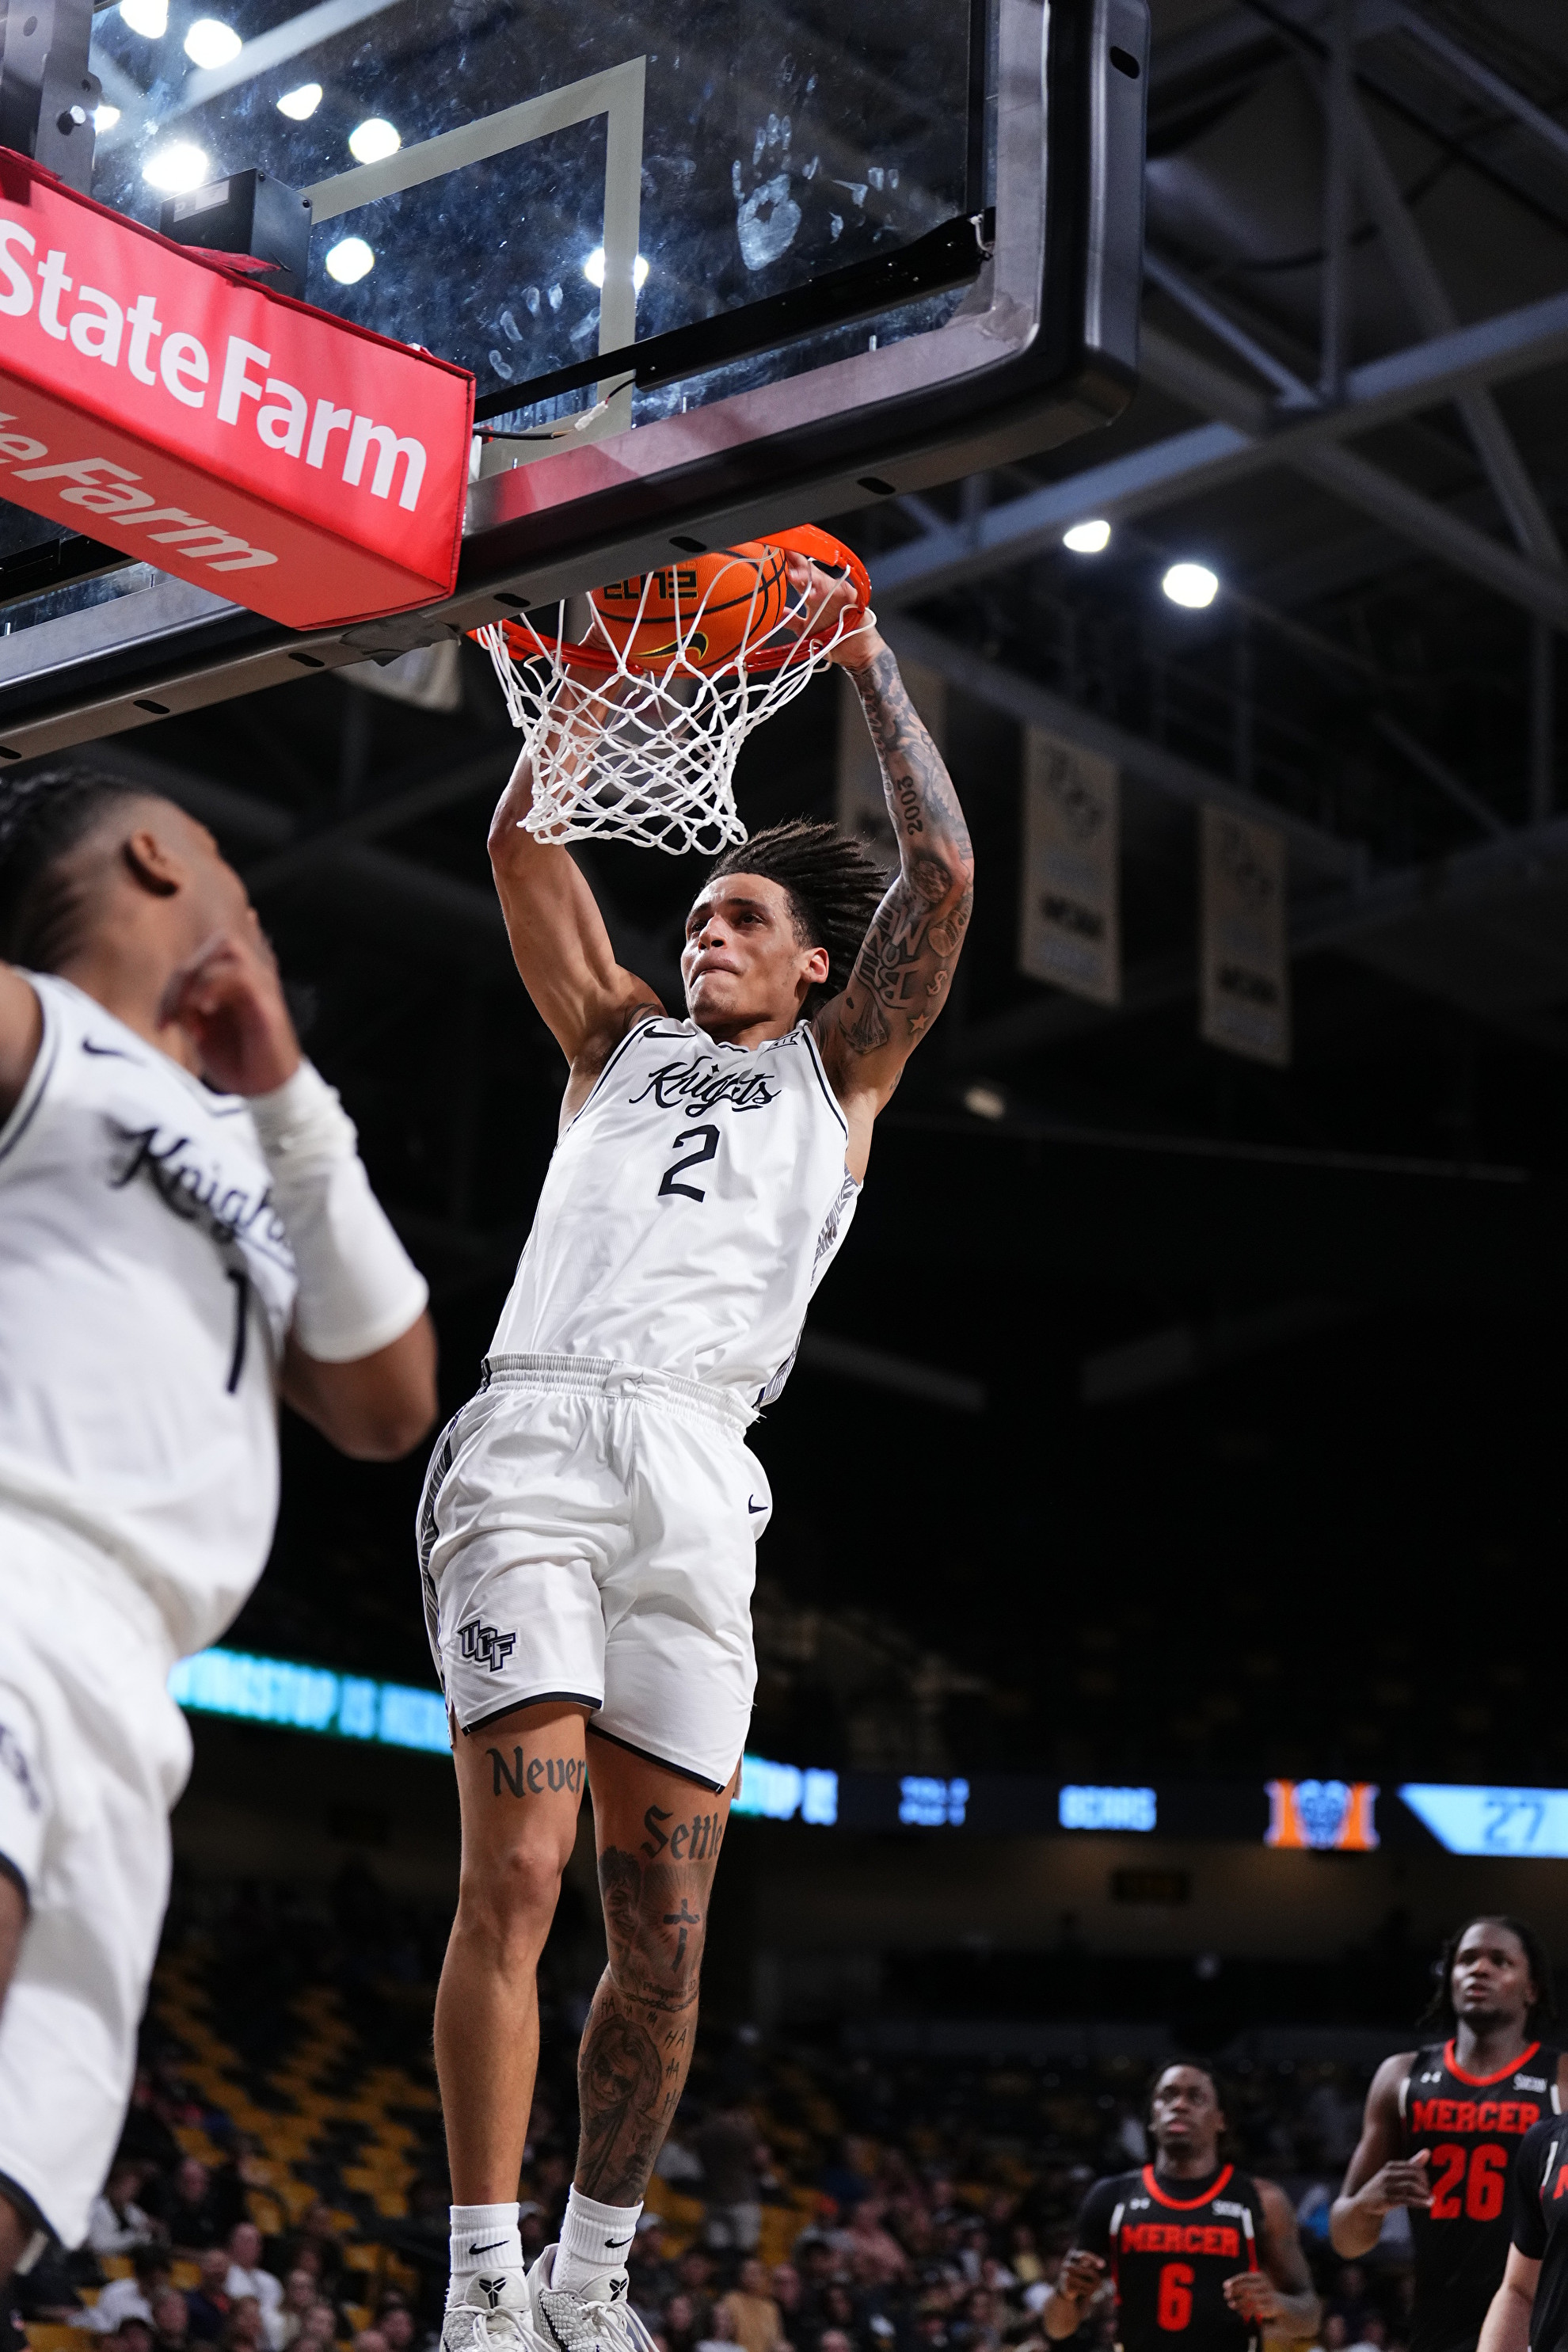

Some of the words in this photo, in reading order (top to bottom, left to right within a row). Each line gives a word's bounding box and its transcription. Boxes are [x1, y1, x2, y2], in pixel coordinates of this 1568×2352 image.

[658, 1124, 721, 1203] 2
[457, 1619, 516, 1673] UCF
[486, 1745, 584, 1799] Never
[640, 1801, 723, 1859] Settle
[663, 2027, 688, 2049] HA
[1412, 2099, 1540, 2134] MERCER
[1430, 2143, 1509, 2222] 26
[1121, 2223, 1240, 2258] MERCER
[1156, 2262, 1195, 2332] 6
